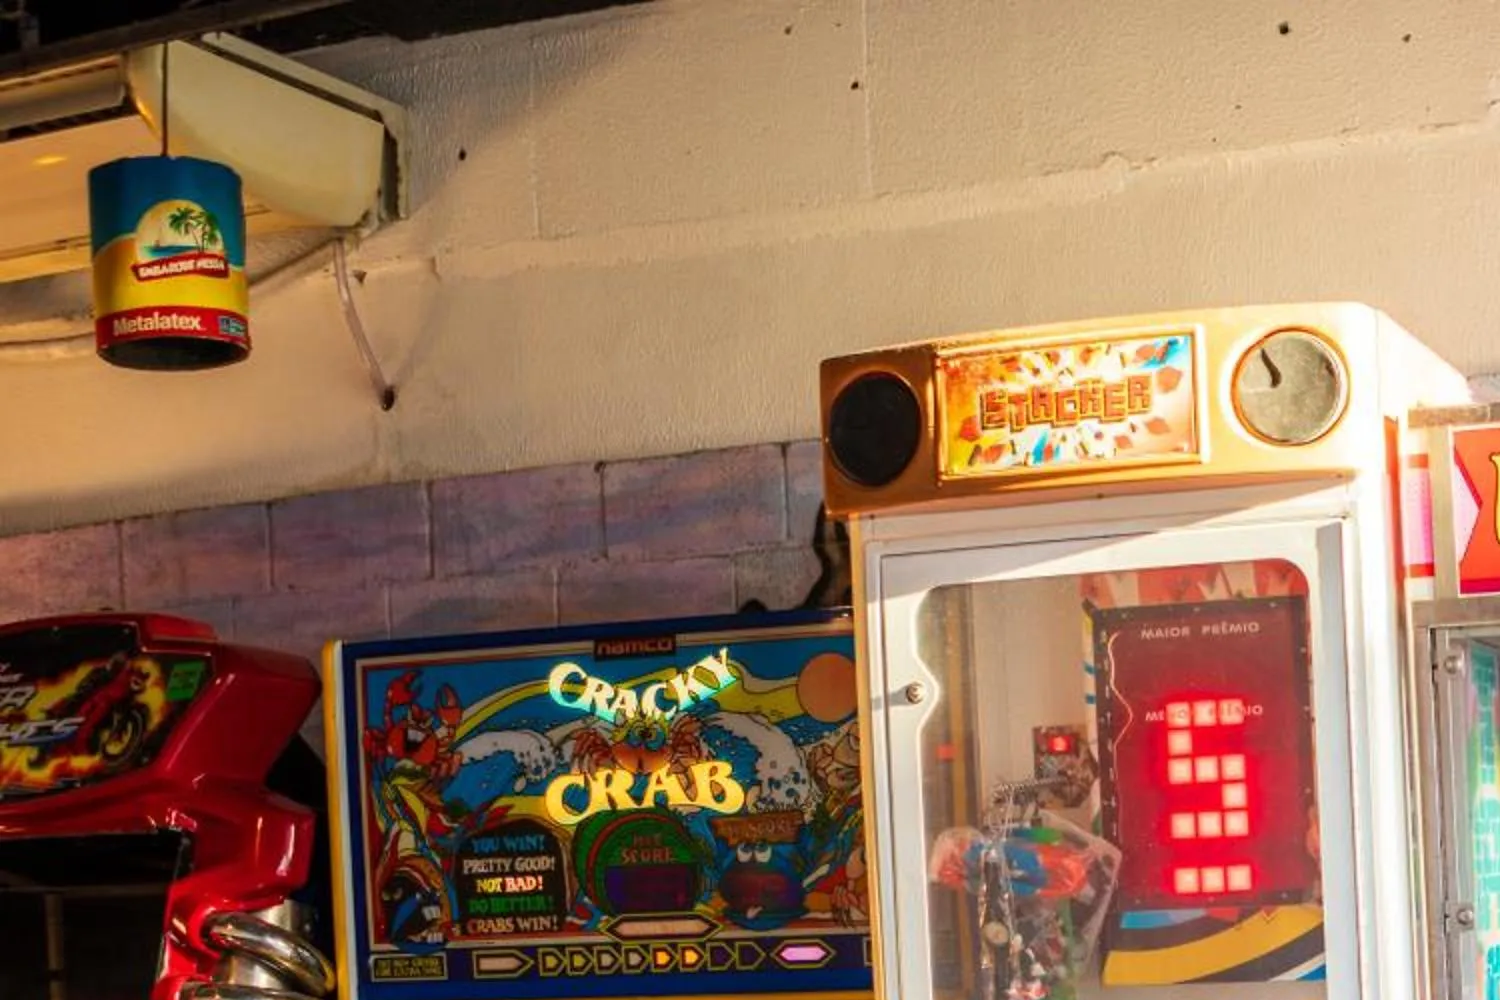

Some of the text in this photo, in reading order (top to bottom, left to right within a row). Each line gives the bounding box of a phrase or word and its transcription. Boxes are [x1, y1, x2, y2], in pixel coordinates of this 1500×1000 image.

[113, 311, 202, 337] Metalatex
[1141, 621, 1260, 641] MAIOR PRÊMIO
[596, 636, 674, 655] namco
[549, 646, 738, 724] CRACKY
[545, 758, 746, 825] CRAB
[476, 875, 543, 893] NOT BAD!
[467, 916, 514, 934] CRABS
